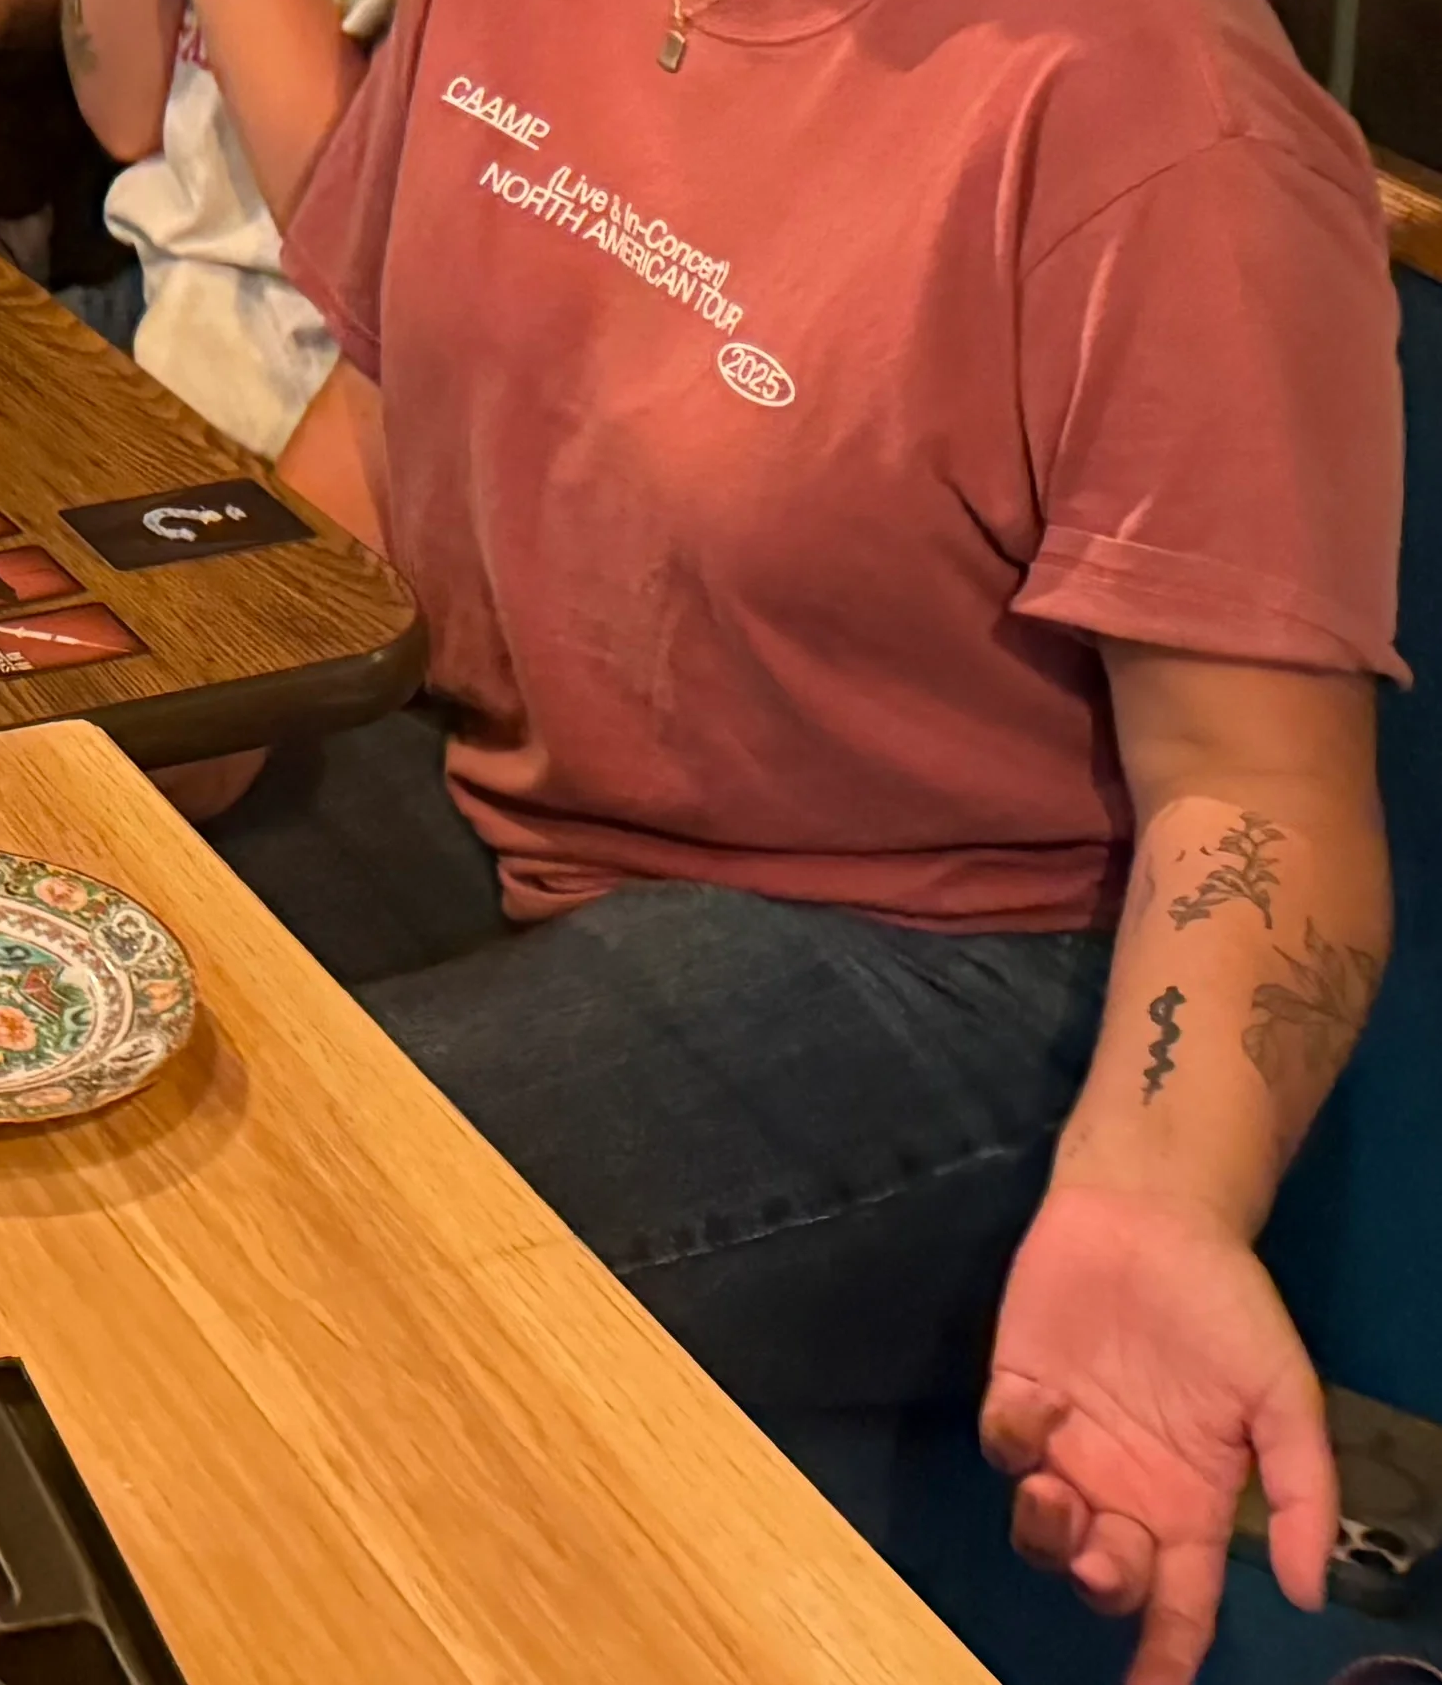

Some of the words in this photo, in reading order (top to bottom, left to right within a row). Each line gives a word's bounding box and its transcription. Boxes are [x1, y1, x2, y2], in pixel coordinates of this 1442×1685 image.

[442, 75, 552, 147] CAAMP
[479, 162, 589, 234] NORTH
[582, 218, 698, 304] AMERICAN
[693, 282, 744, 337] TOUR
[547, 165, 609, 213] (Live
[624, 201, 731, 290] In-Concert)
[724, 347, 784, 400] 2025
